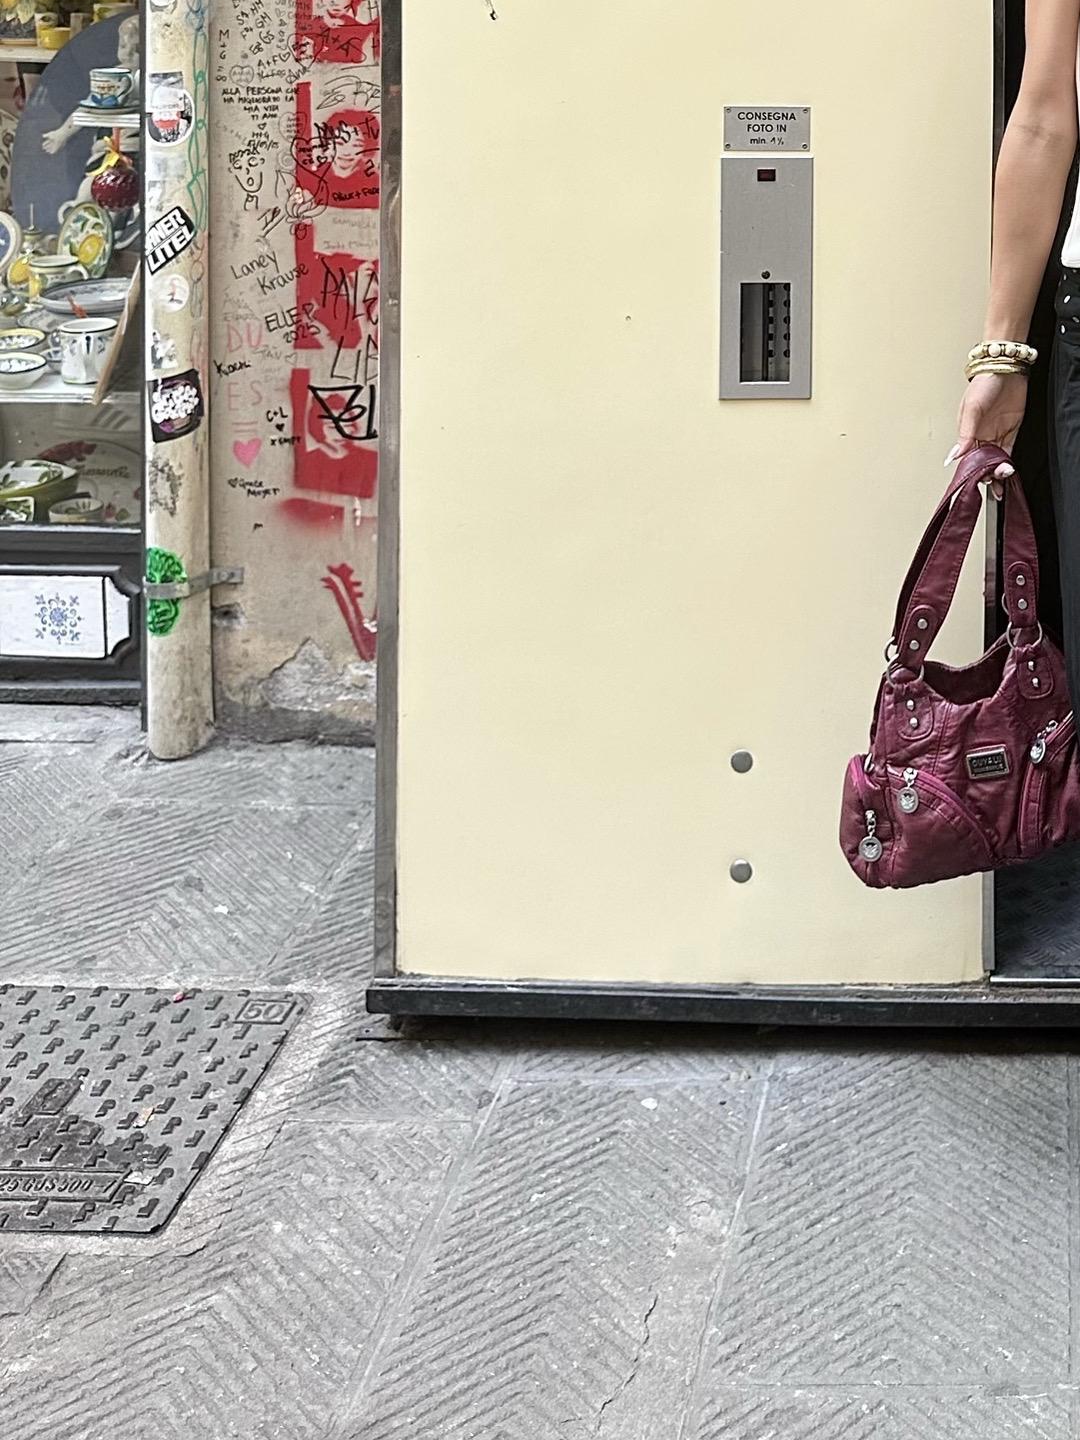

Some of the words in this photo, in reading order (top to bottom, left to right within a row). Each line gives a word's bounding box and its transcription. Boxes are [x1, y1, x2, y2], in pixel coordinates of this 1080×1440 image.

[737, 112, 796, 122] CONSEGNA
[747, 123, 771, 133] FOTO
[776, 124, 787, 133] IN
[230, 250, 280, 280] Laney
[257, 263, 309, 296] Krause
